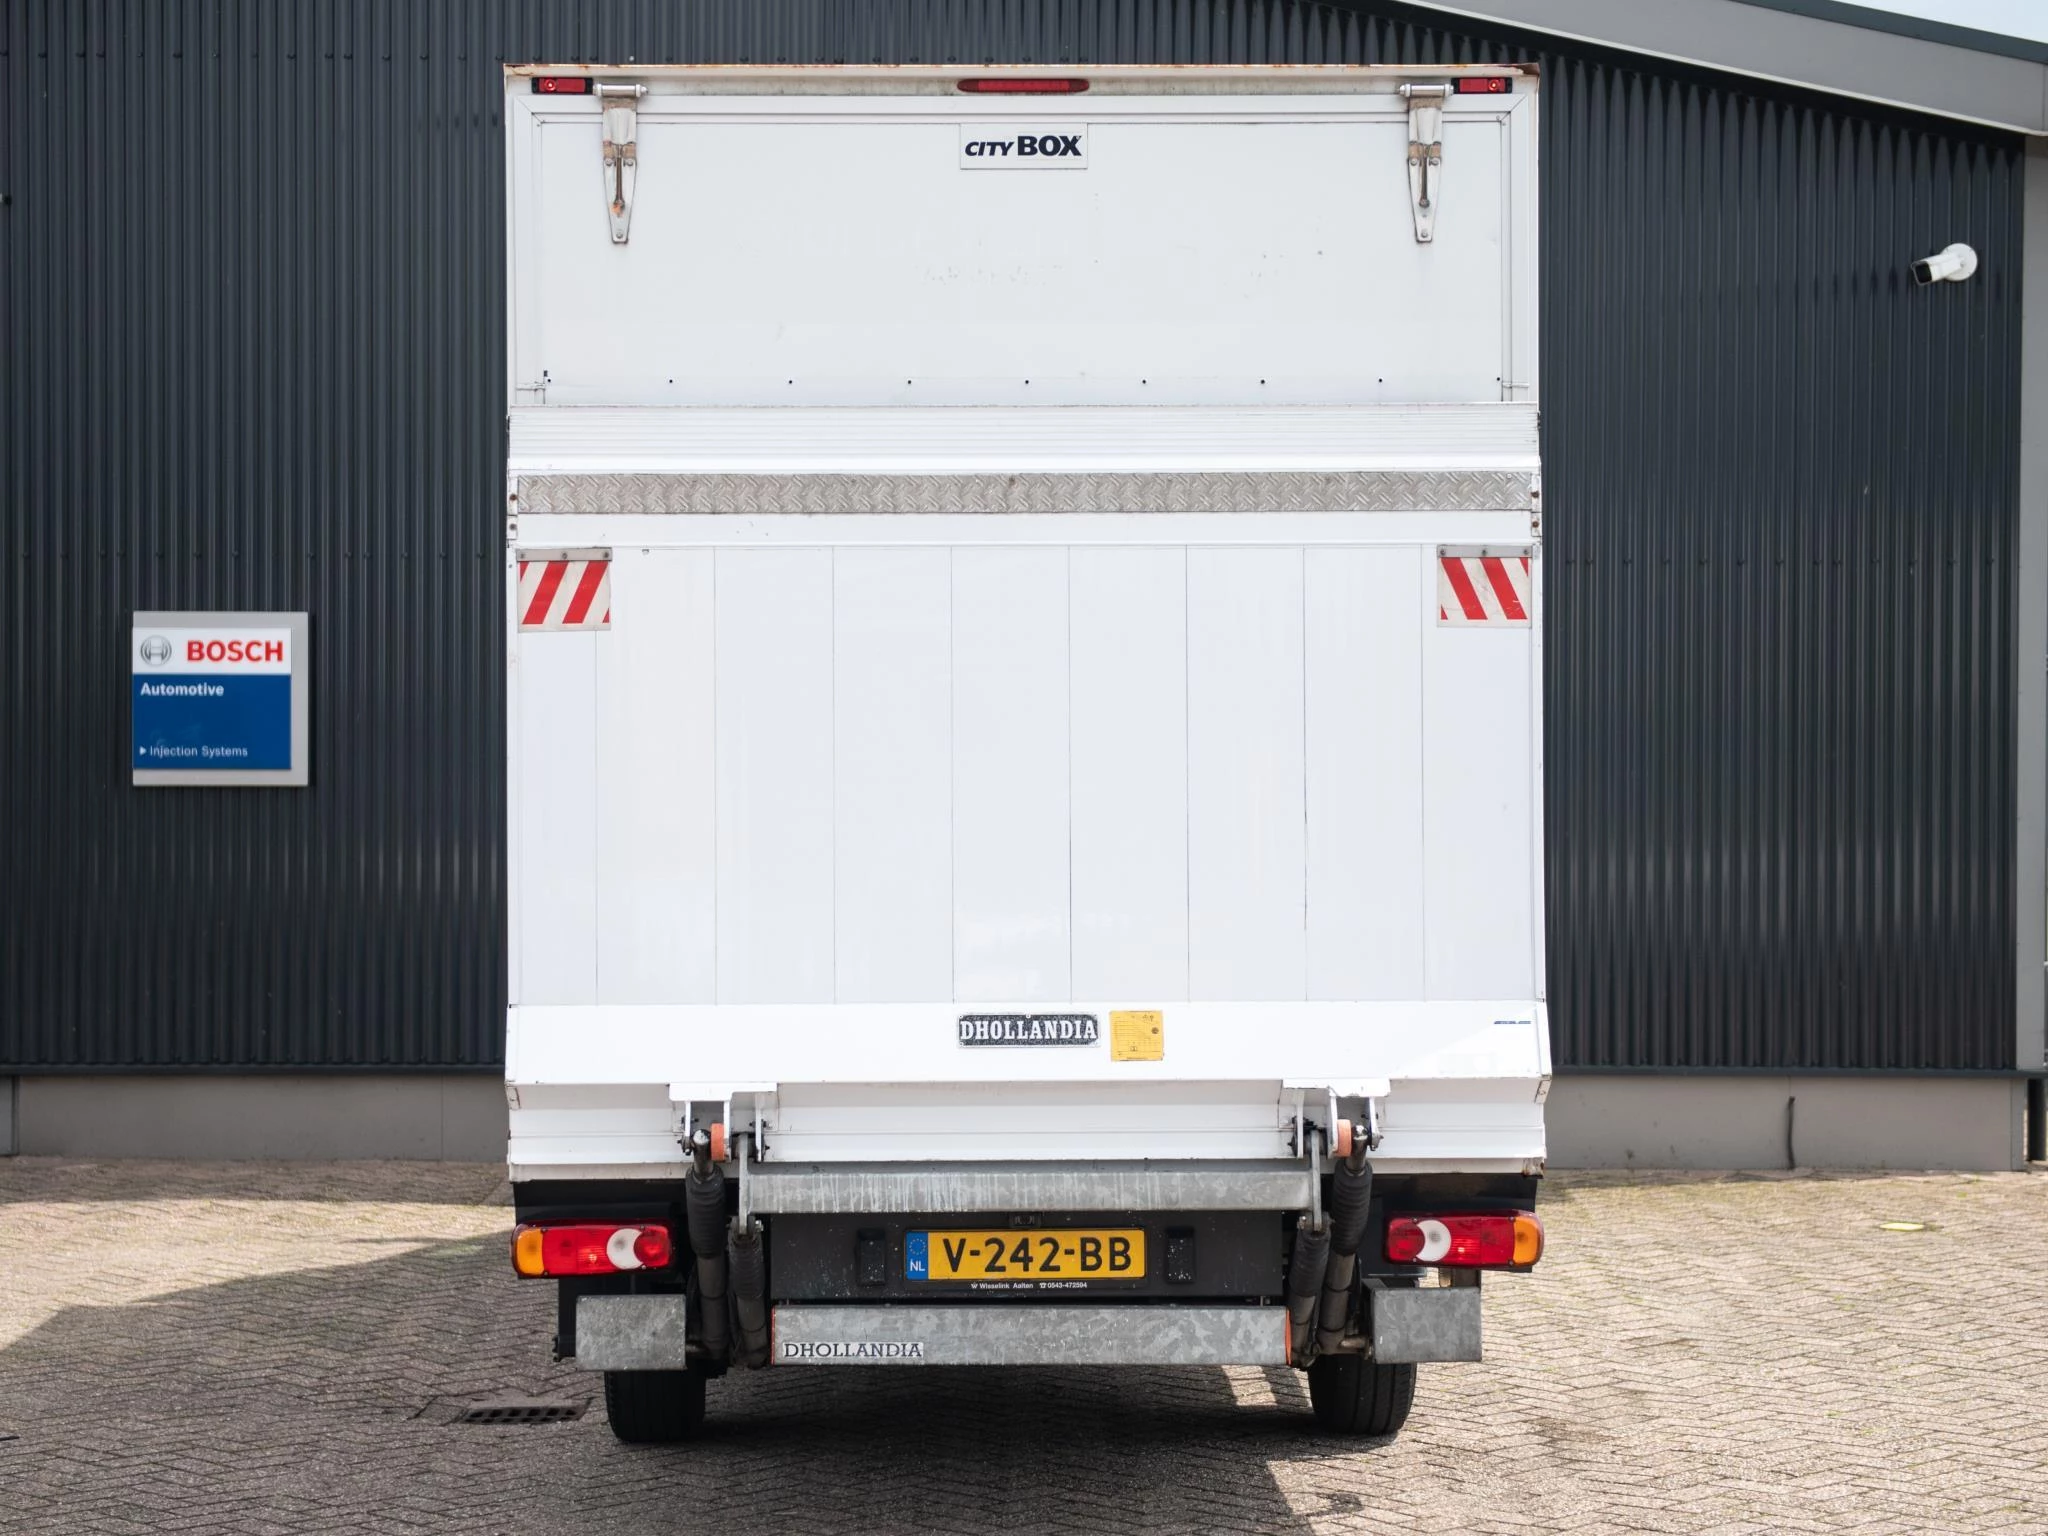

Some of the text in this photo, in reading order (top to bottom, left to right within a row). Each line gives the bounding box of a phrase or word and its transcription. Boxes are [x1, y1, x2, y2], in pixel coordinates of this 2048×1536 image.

[964, 135, 1082, 156] CITY BOX
[186, 640, 284, 662] BOSCH
[140, 682, 225, 696] Automotive
[150, 745, 248, 759] Injection Systems
[960, 1020, 1097, 1040] DHOLLANDIA
[942, 1237, 1132, 1272] V-242-BB
[909, 1260, 926, 1272] NL
[1012, 1282, 1034, 1290] Aalten
[784, 1343, 922, 1357] DHOLLANDIA
